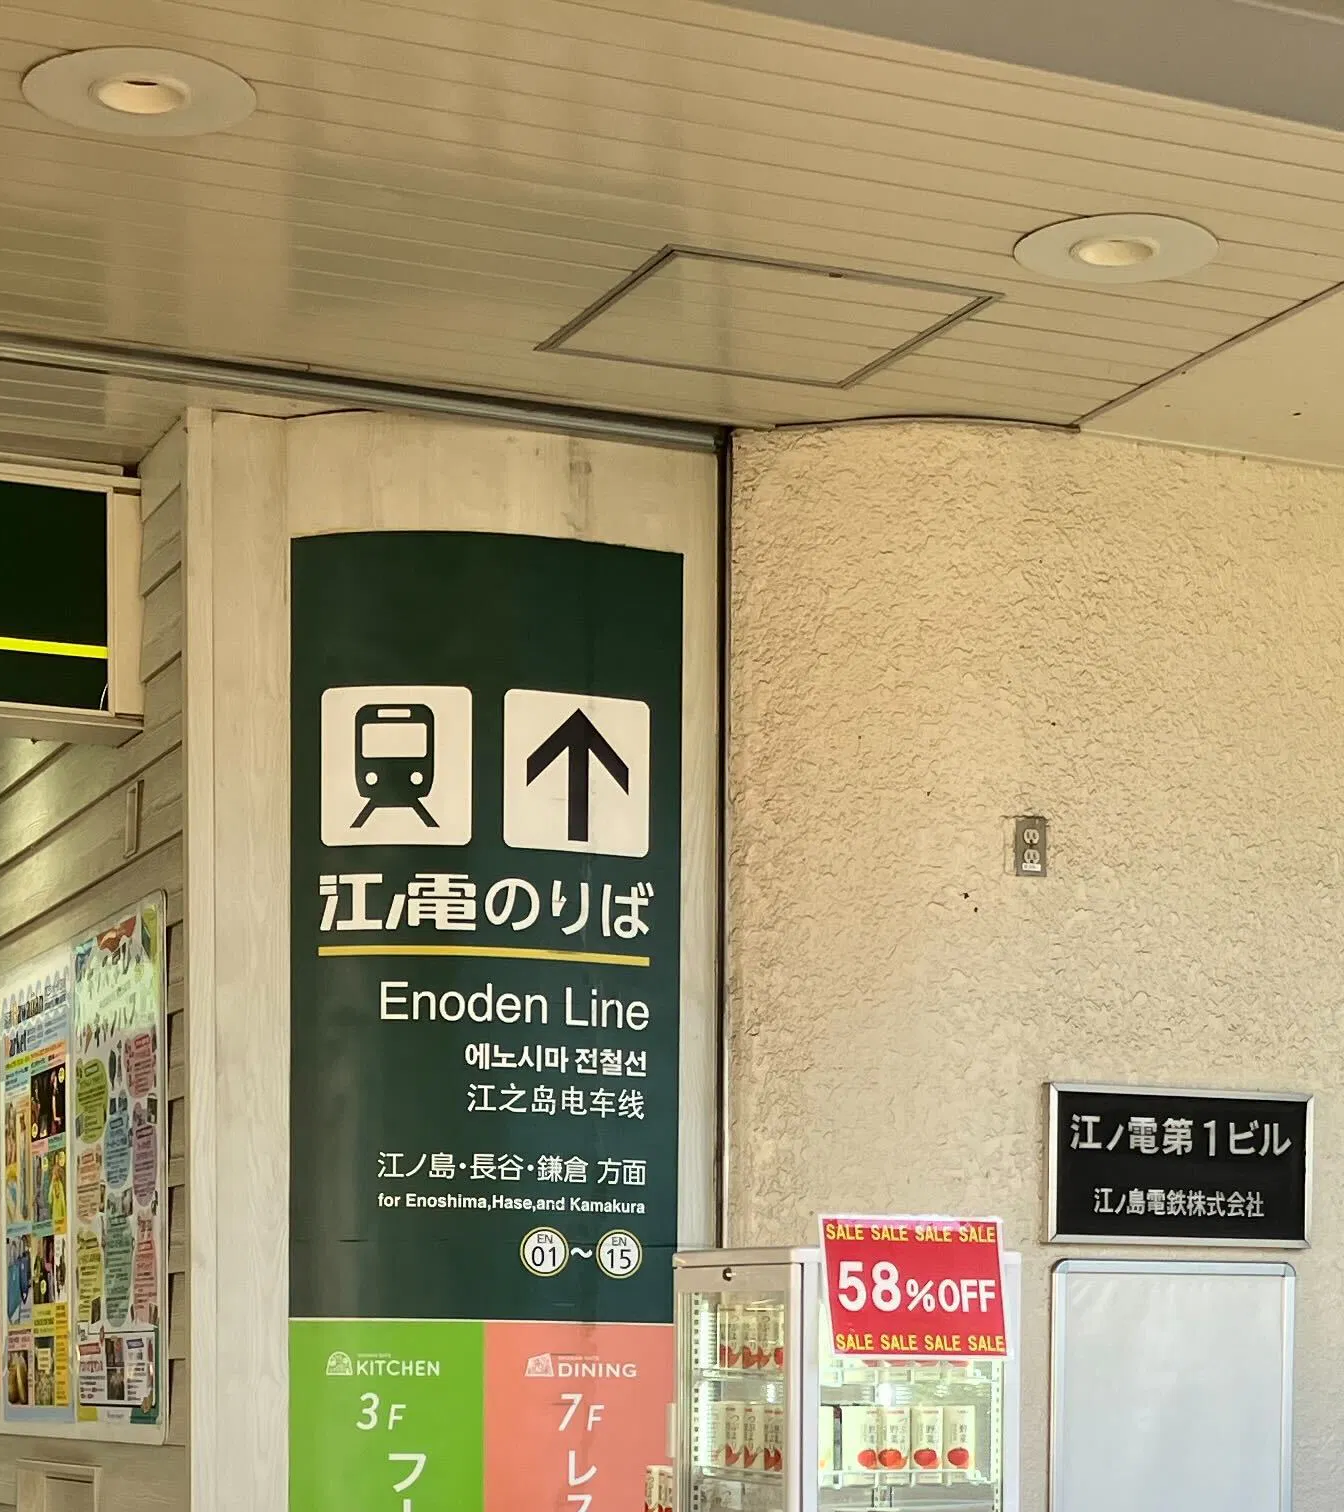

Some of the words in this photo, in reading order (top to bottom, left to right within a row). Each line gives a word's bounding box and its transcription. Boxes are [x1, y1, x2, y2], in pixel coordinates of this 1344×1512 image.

[379, 981, 549, 1025] Enoden
[564, 985, 650, 1031] Line
[465, 1043, 569, 1074] 에노시마
[574, 1044, 647, 1078] 전철선
[466, 1083, 645, 1120] 江之岛电车线
[597, 1157, 647, 1187] 方面
[378, 1192, 401, 1209] for
[569, 1195, 646, 1215] Kamakura
[1093, 1187, 1265, 1218] 江ノ島電鉄株式会社
[536, 1233, 555, 1246] EN
[611, 1236, 628, 1247] EN
[825, 1223, 865, 1242] SALE
[870, 1223, 909, 1242] SALE
[914, 1224, 953, 1243] SALE
[958, 1225, 996, 1244] SALE
[531, 1246, 559, 1268] 01
[605, 1247, 633, 1271] 15
[835, 1333, 874, 1352] SALE
[880, 1333, 918, 1352] SALE
[924, 1333, 962, 1352] SALE
[967, 1334, 1006, 1353] SALE
[356, 1360, 440, 1377] KITCHEN
[558, 1362, 637, 1379] DINING
